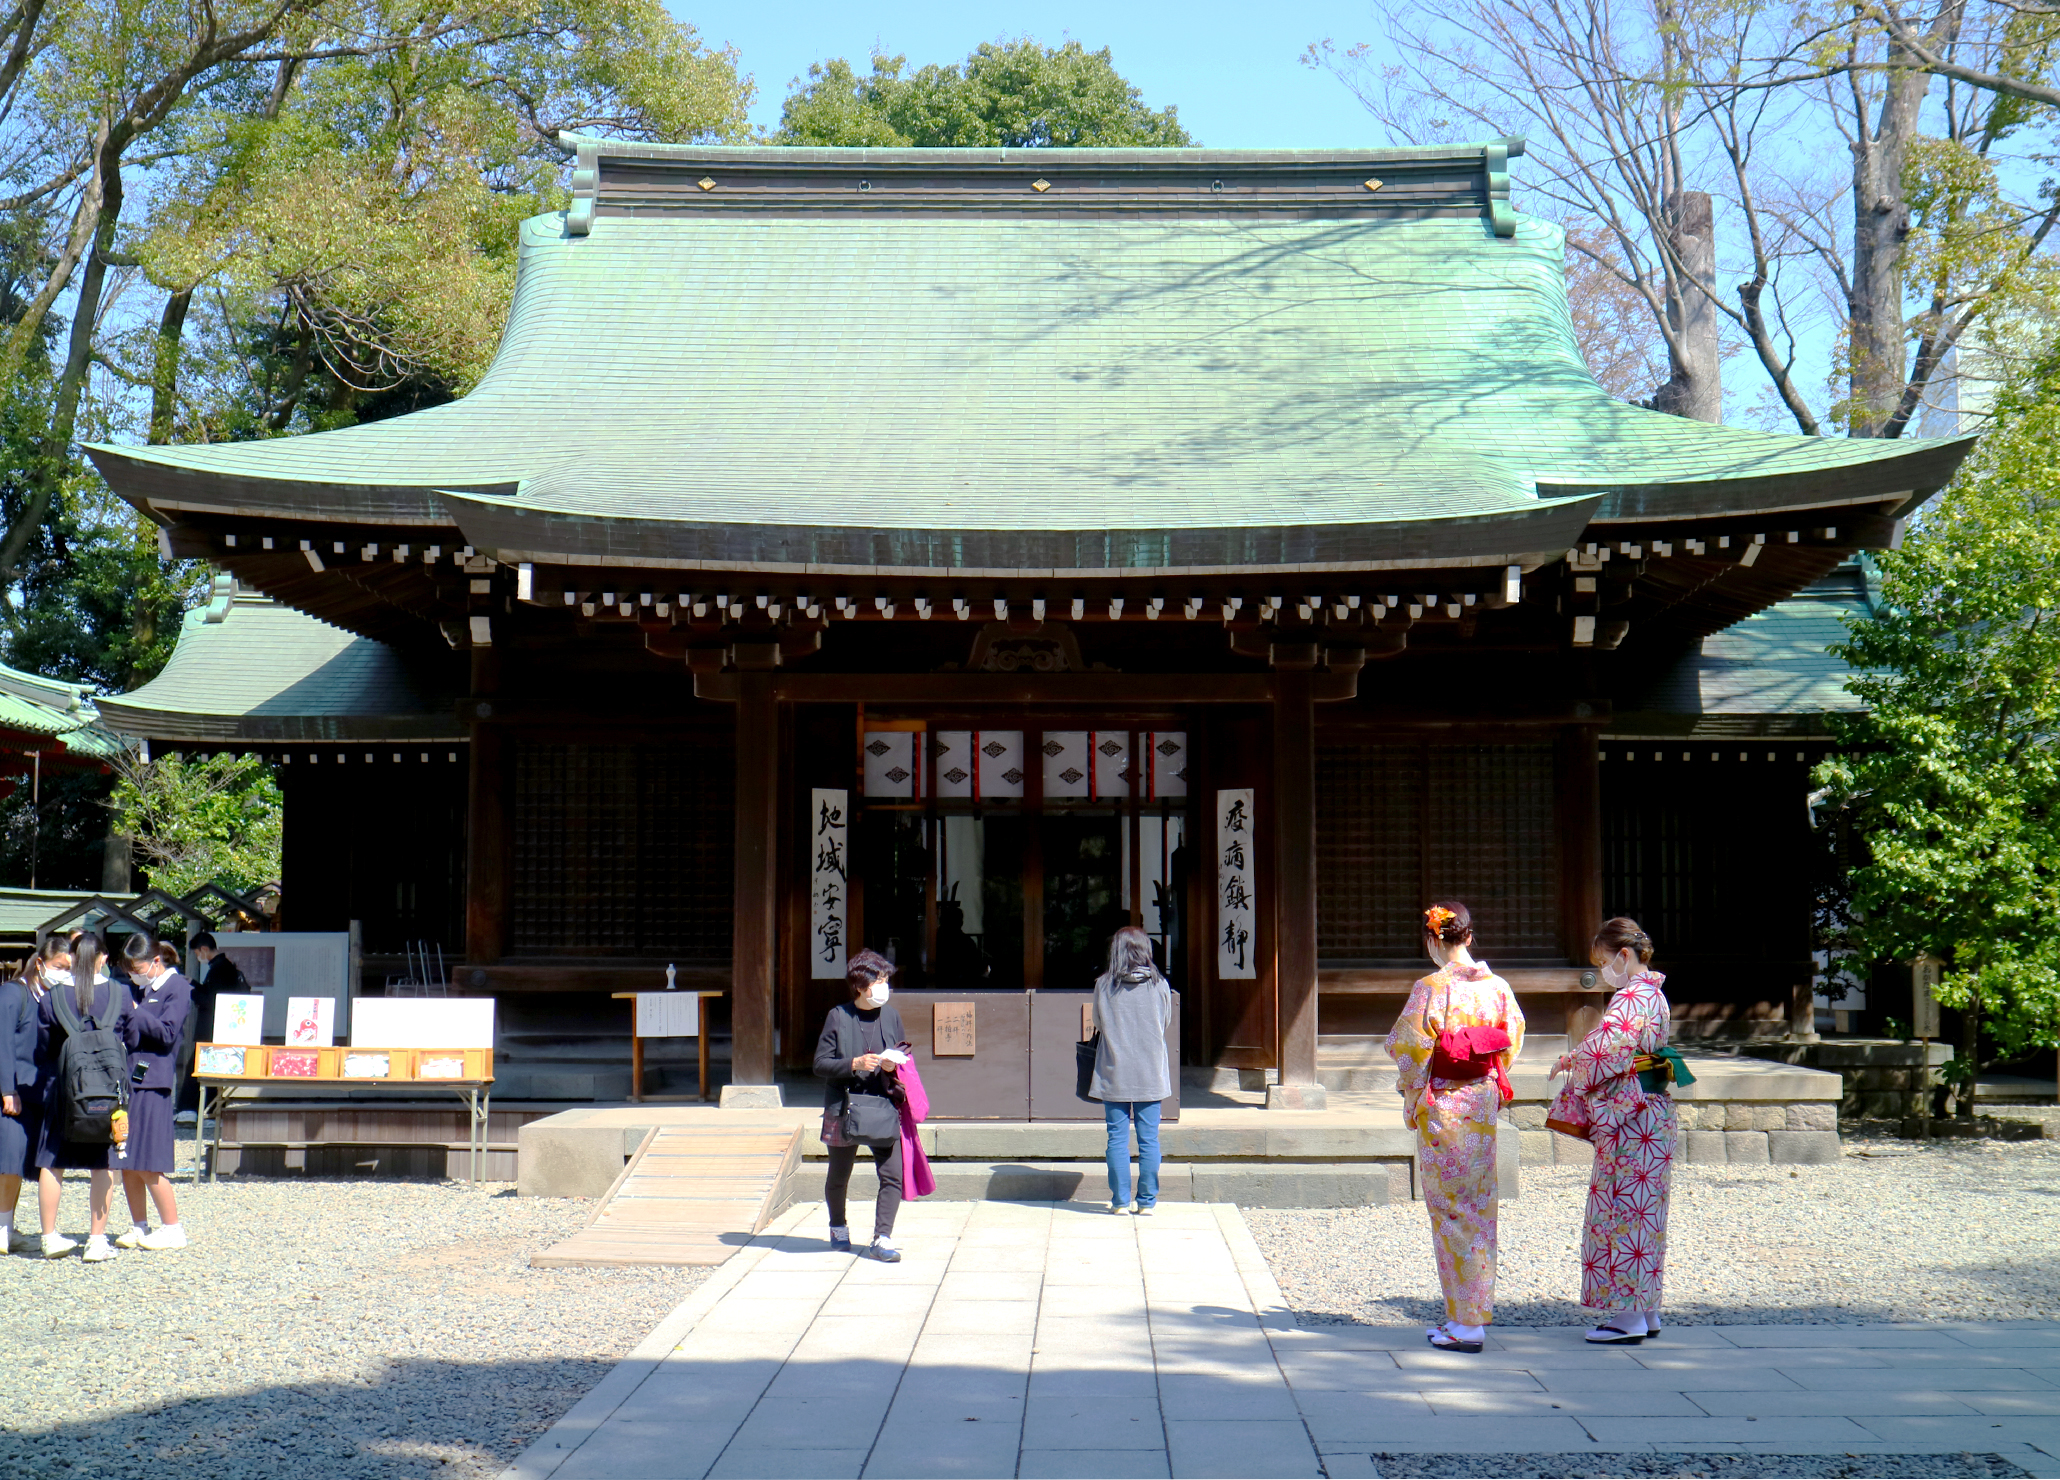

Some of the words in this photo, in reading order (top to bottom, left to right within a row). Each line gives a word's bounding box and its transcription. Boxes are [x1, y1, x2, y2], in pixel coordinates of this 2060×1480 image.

[815, 798, 847, 963] 地域安寧
[1222, 799, 1252, 970] 疫病鎮静
